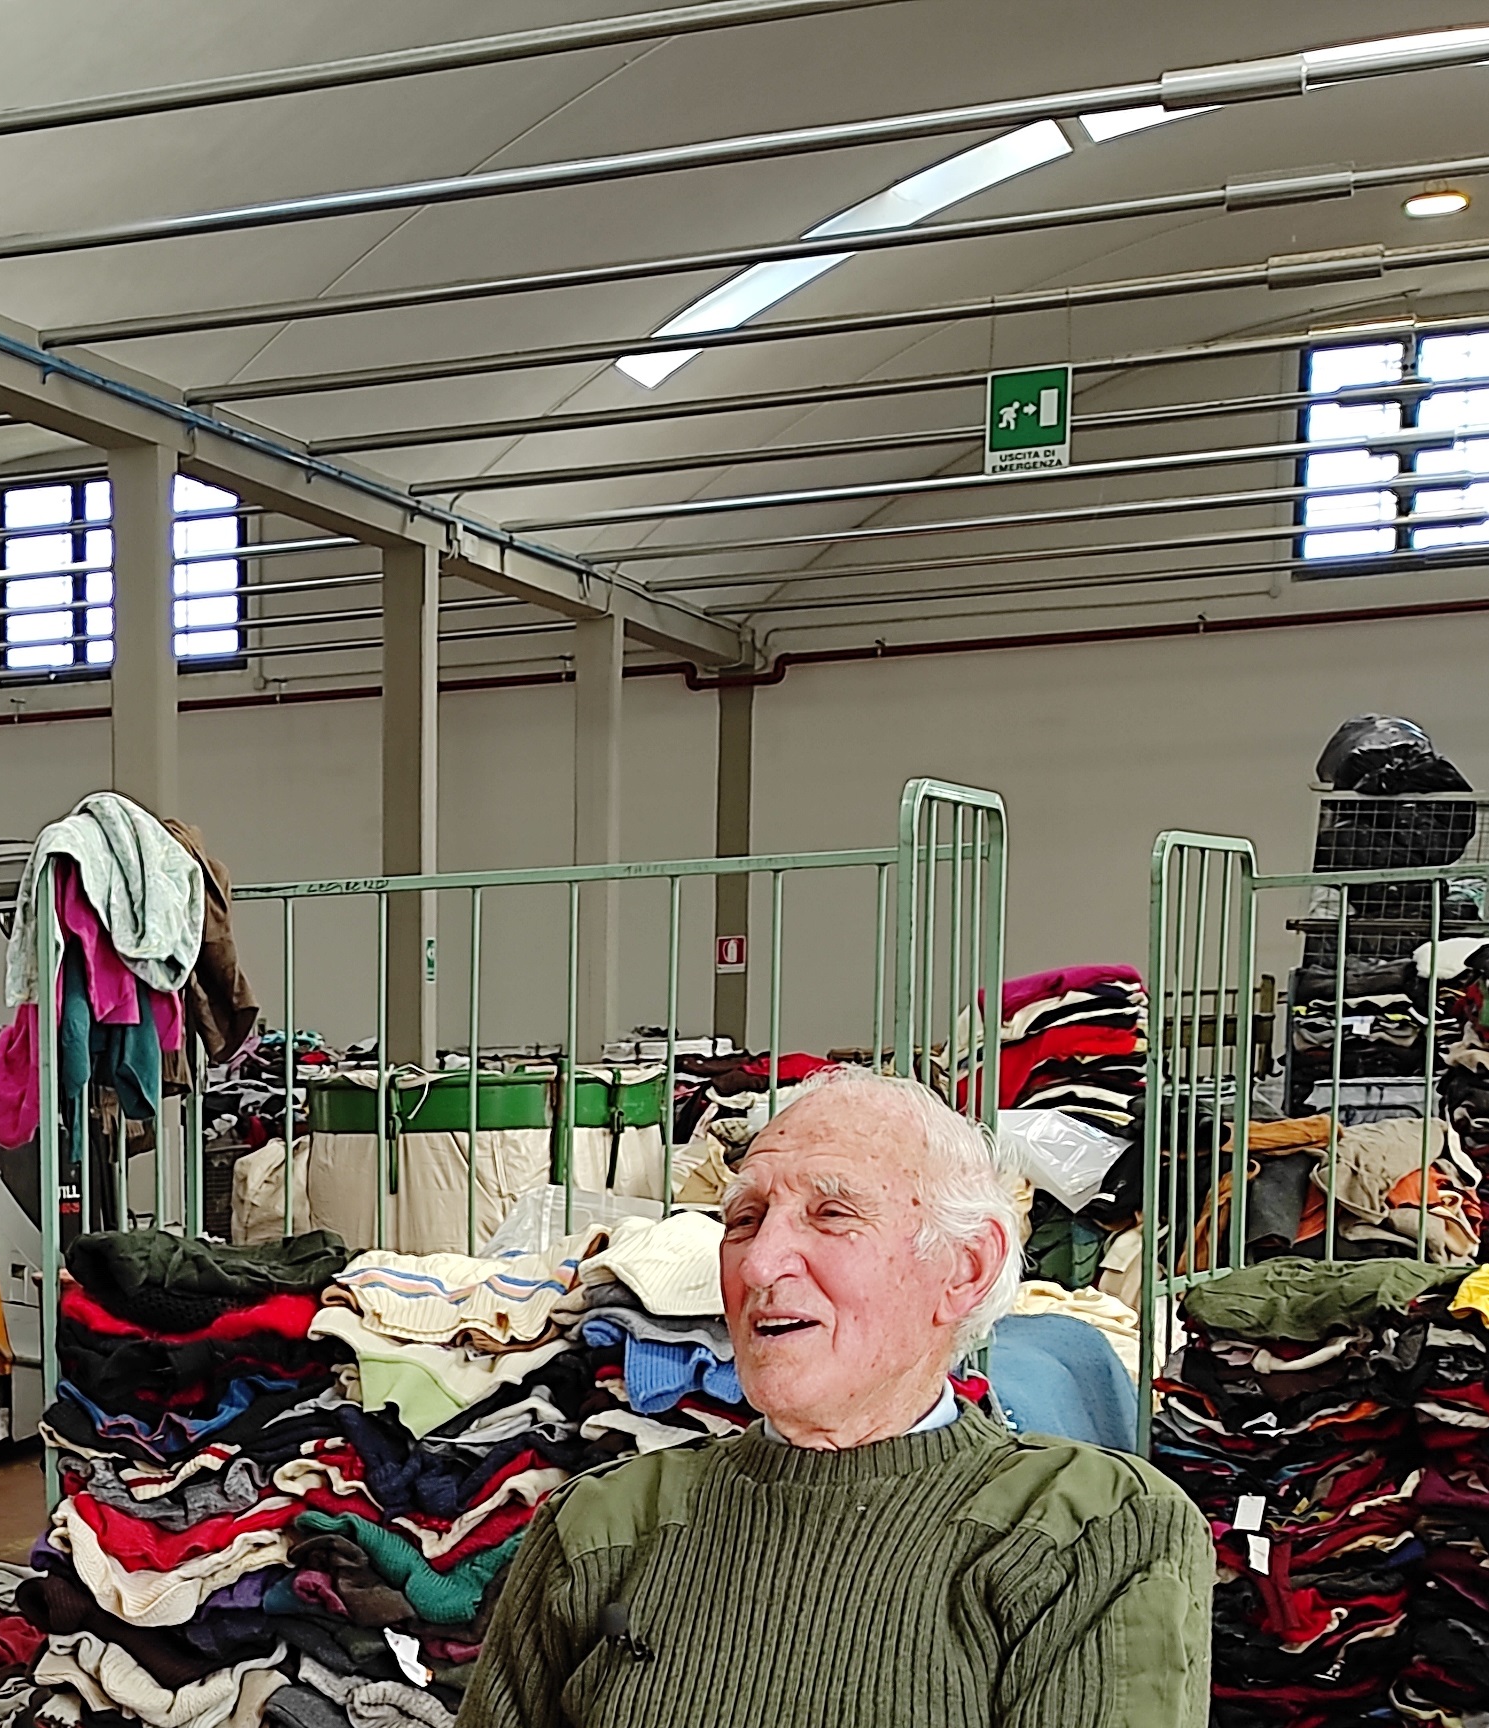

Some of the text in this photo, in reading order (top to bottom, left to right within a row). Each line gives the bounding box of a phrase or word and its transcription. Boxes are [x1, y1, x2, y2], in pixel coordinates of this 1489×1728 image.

[999, 449, 1055, 462] USCITA DI
[991, 459, 1063, 473] EMERGENZA
